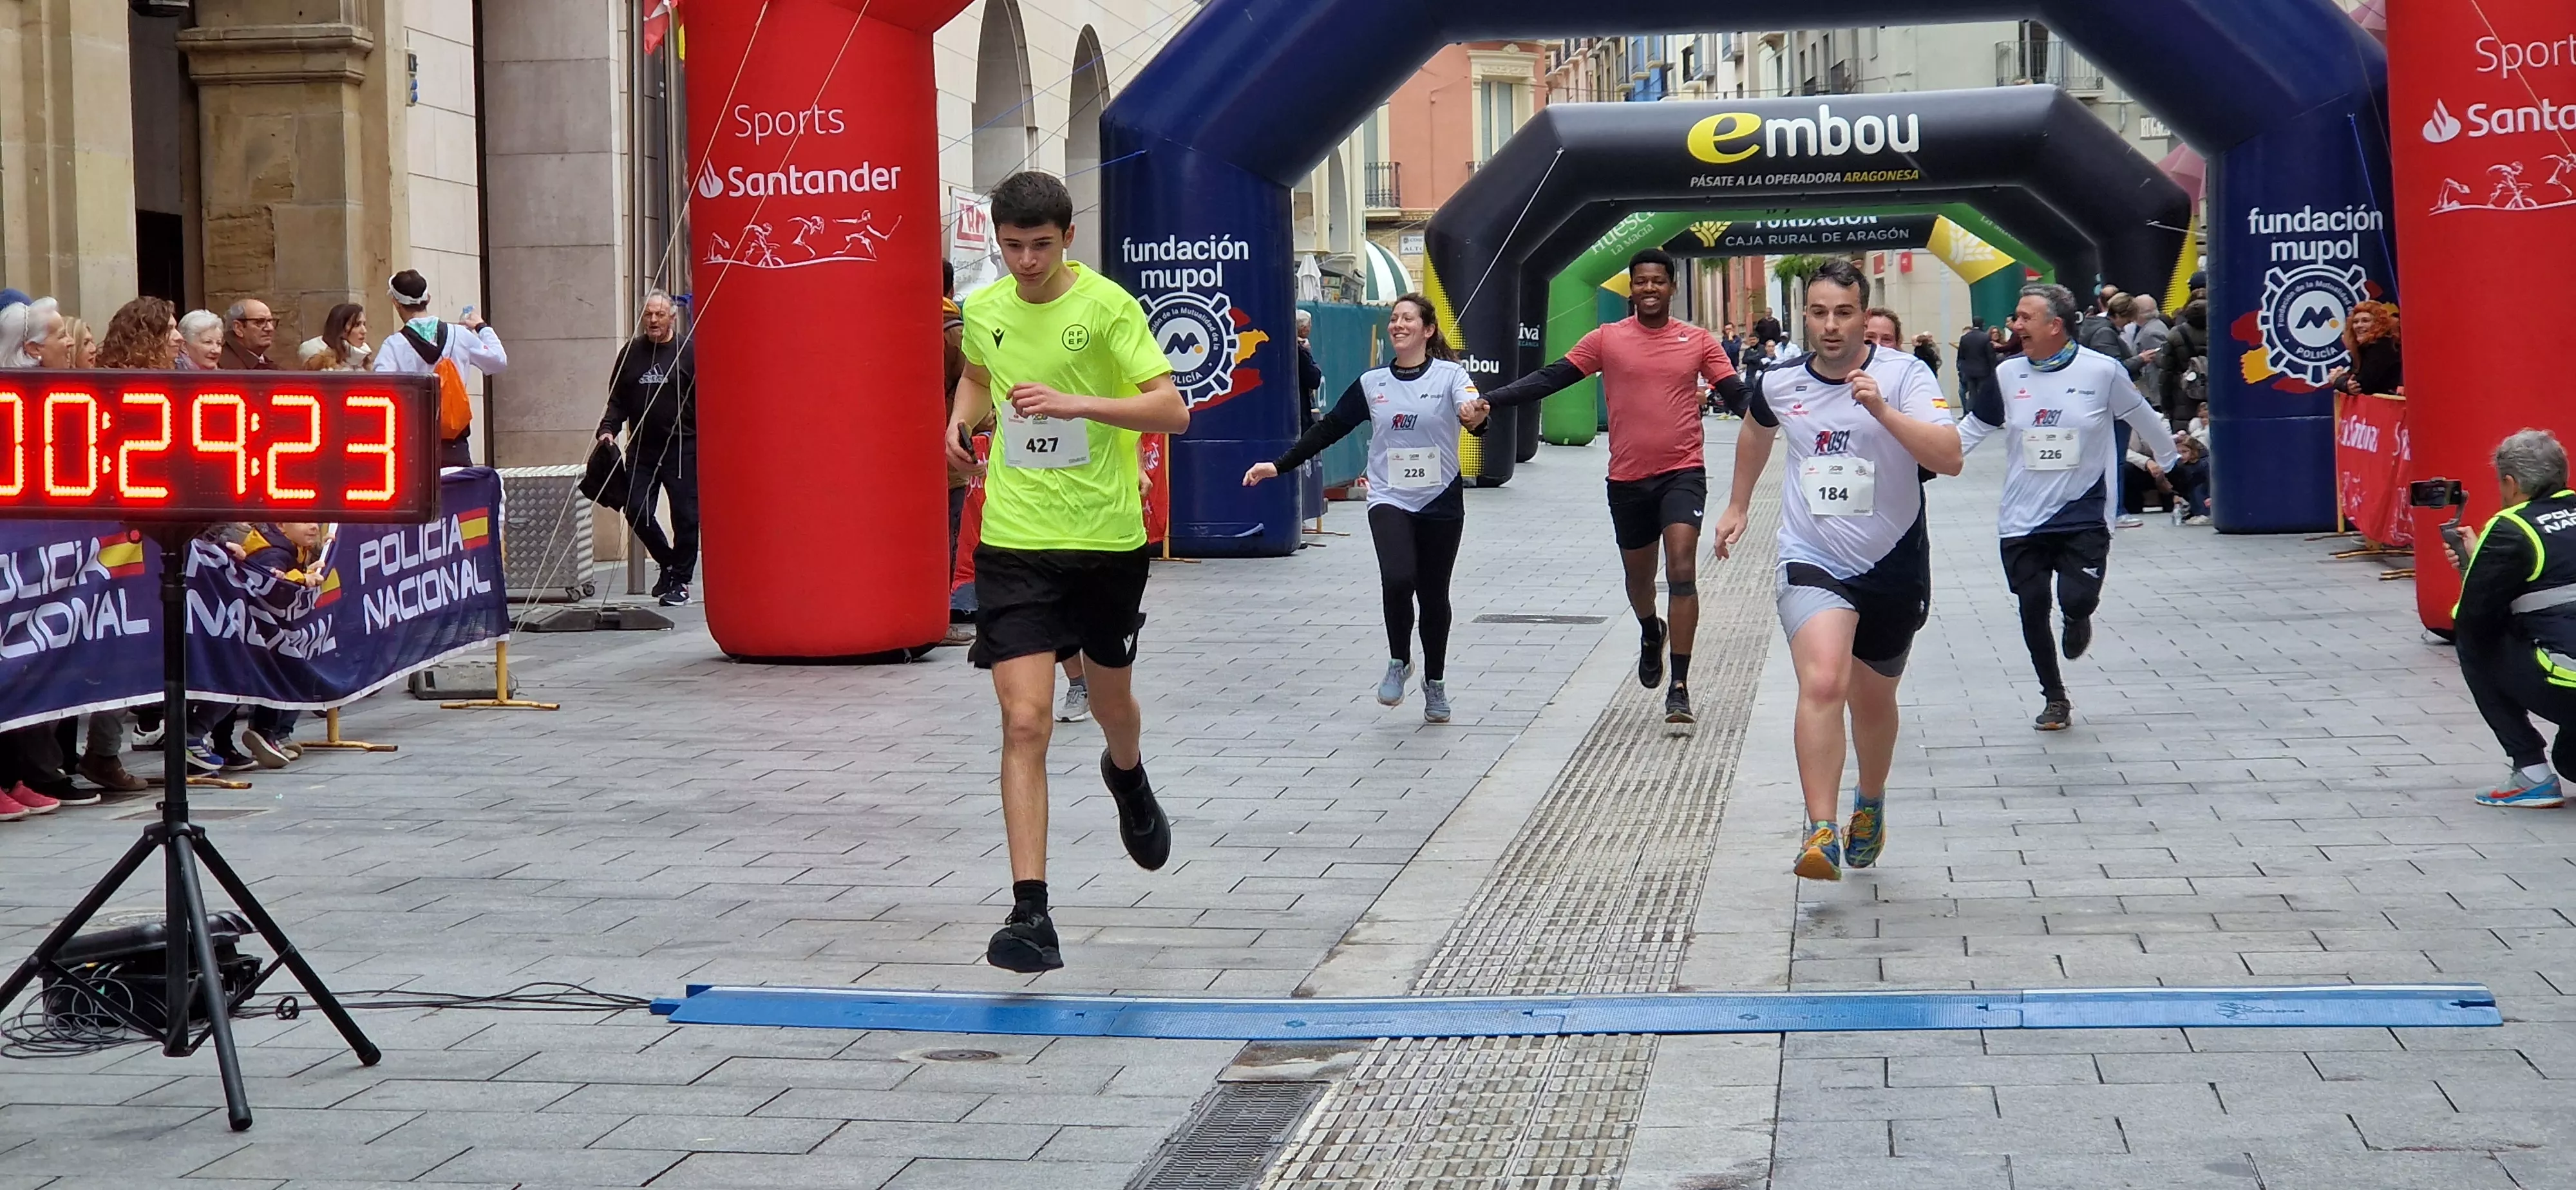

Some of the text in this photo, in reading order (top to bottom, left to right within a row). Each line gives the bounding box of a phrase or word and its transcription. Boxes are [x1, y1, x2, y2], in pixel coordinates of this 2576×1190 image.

[734, 104, 846, 146] Sports
[1687, 104, 1920, 164] embou
[728, 161, 901, 197] Santander
[1690, 169, 1920, 187] PÁSATE A LA OPERADORA ARAGONESA
[2248, 203, 2383, 234] fundación
[1725, 227, 1909, 247] CAJA RURAL DE ARAGÓN
[1122, 234, 1249, 263] fundación
[2270, 232, 2359, 266] mupol
[1141, 261, 1223, 294] mupol
[1162, 311, 1171, 319] de
[1180, 307, 1217, 331] Mutualidad
[1211, 332, 1219, 342] de
[1213, 343, 1221, 351] la
[2296, 346, 2338, 359] POLICÍA
[1170, 371, 1204, 384] OLICÍA
[1026, 437, 1059, 453] 427
[2039, 449, 2062, 460] 226
[1404, 468, 1425, 478] 228
[1818, 486, 1849, 501] 184
[360, 513, 464, 585] POLICÍA
[363, 556, 492, 636] NACIONAL
[0, 587, 150, 659] CIONAL
